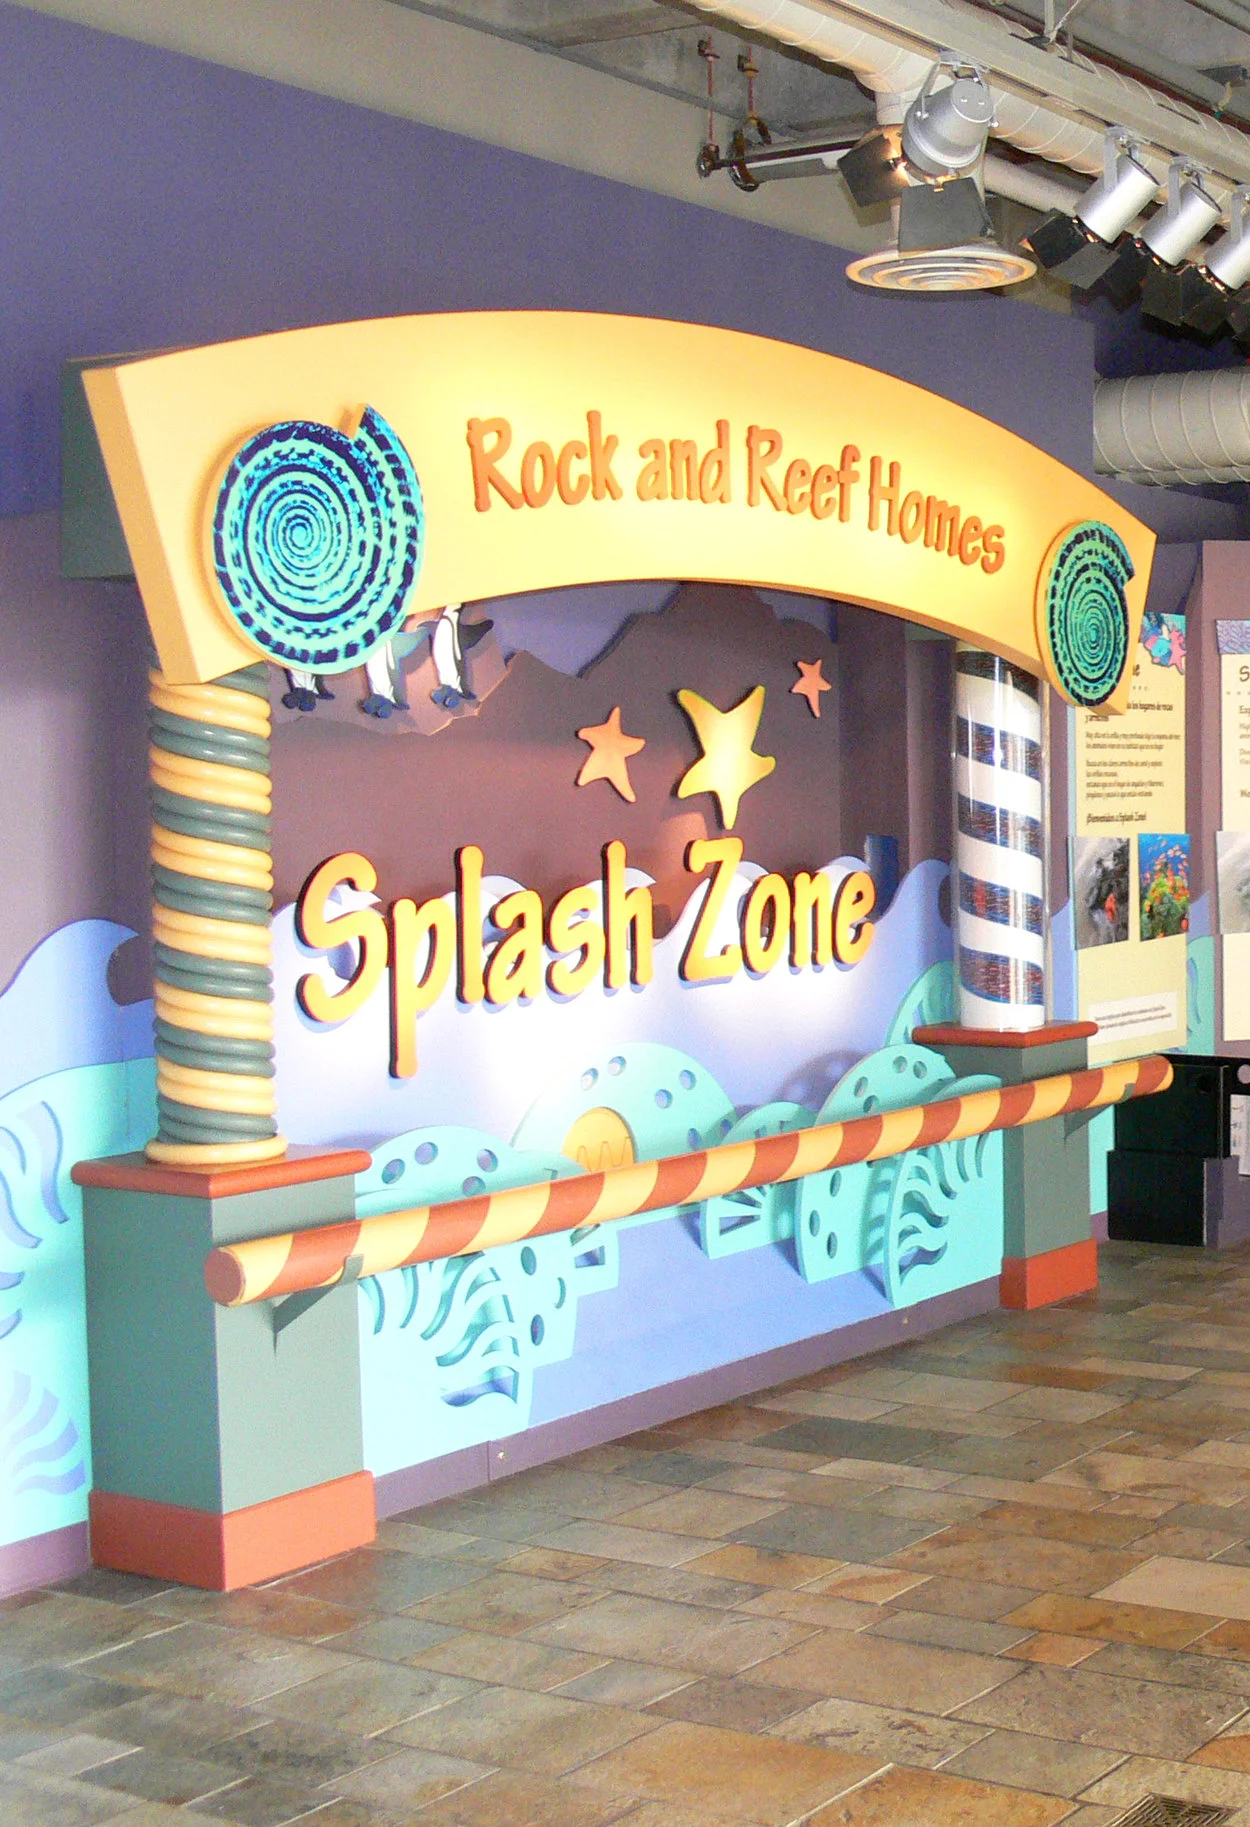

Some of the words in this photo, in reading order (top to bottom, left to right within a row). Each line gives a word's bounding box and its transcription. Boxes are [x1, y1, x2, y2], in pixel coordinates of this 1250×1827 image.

[466, 411, 623, 512] Rock
[637, 419, 732, 504] and
[746, 424, 860, 523] Reef
[867, 455, 1006, 575] Homes
[299, 840, 657, 1081] Splash
[680, 835, 876, 984] Zone
